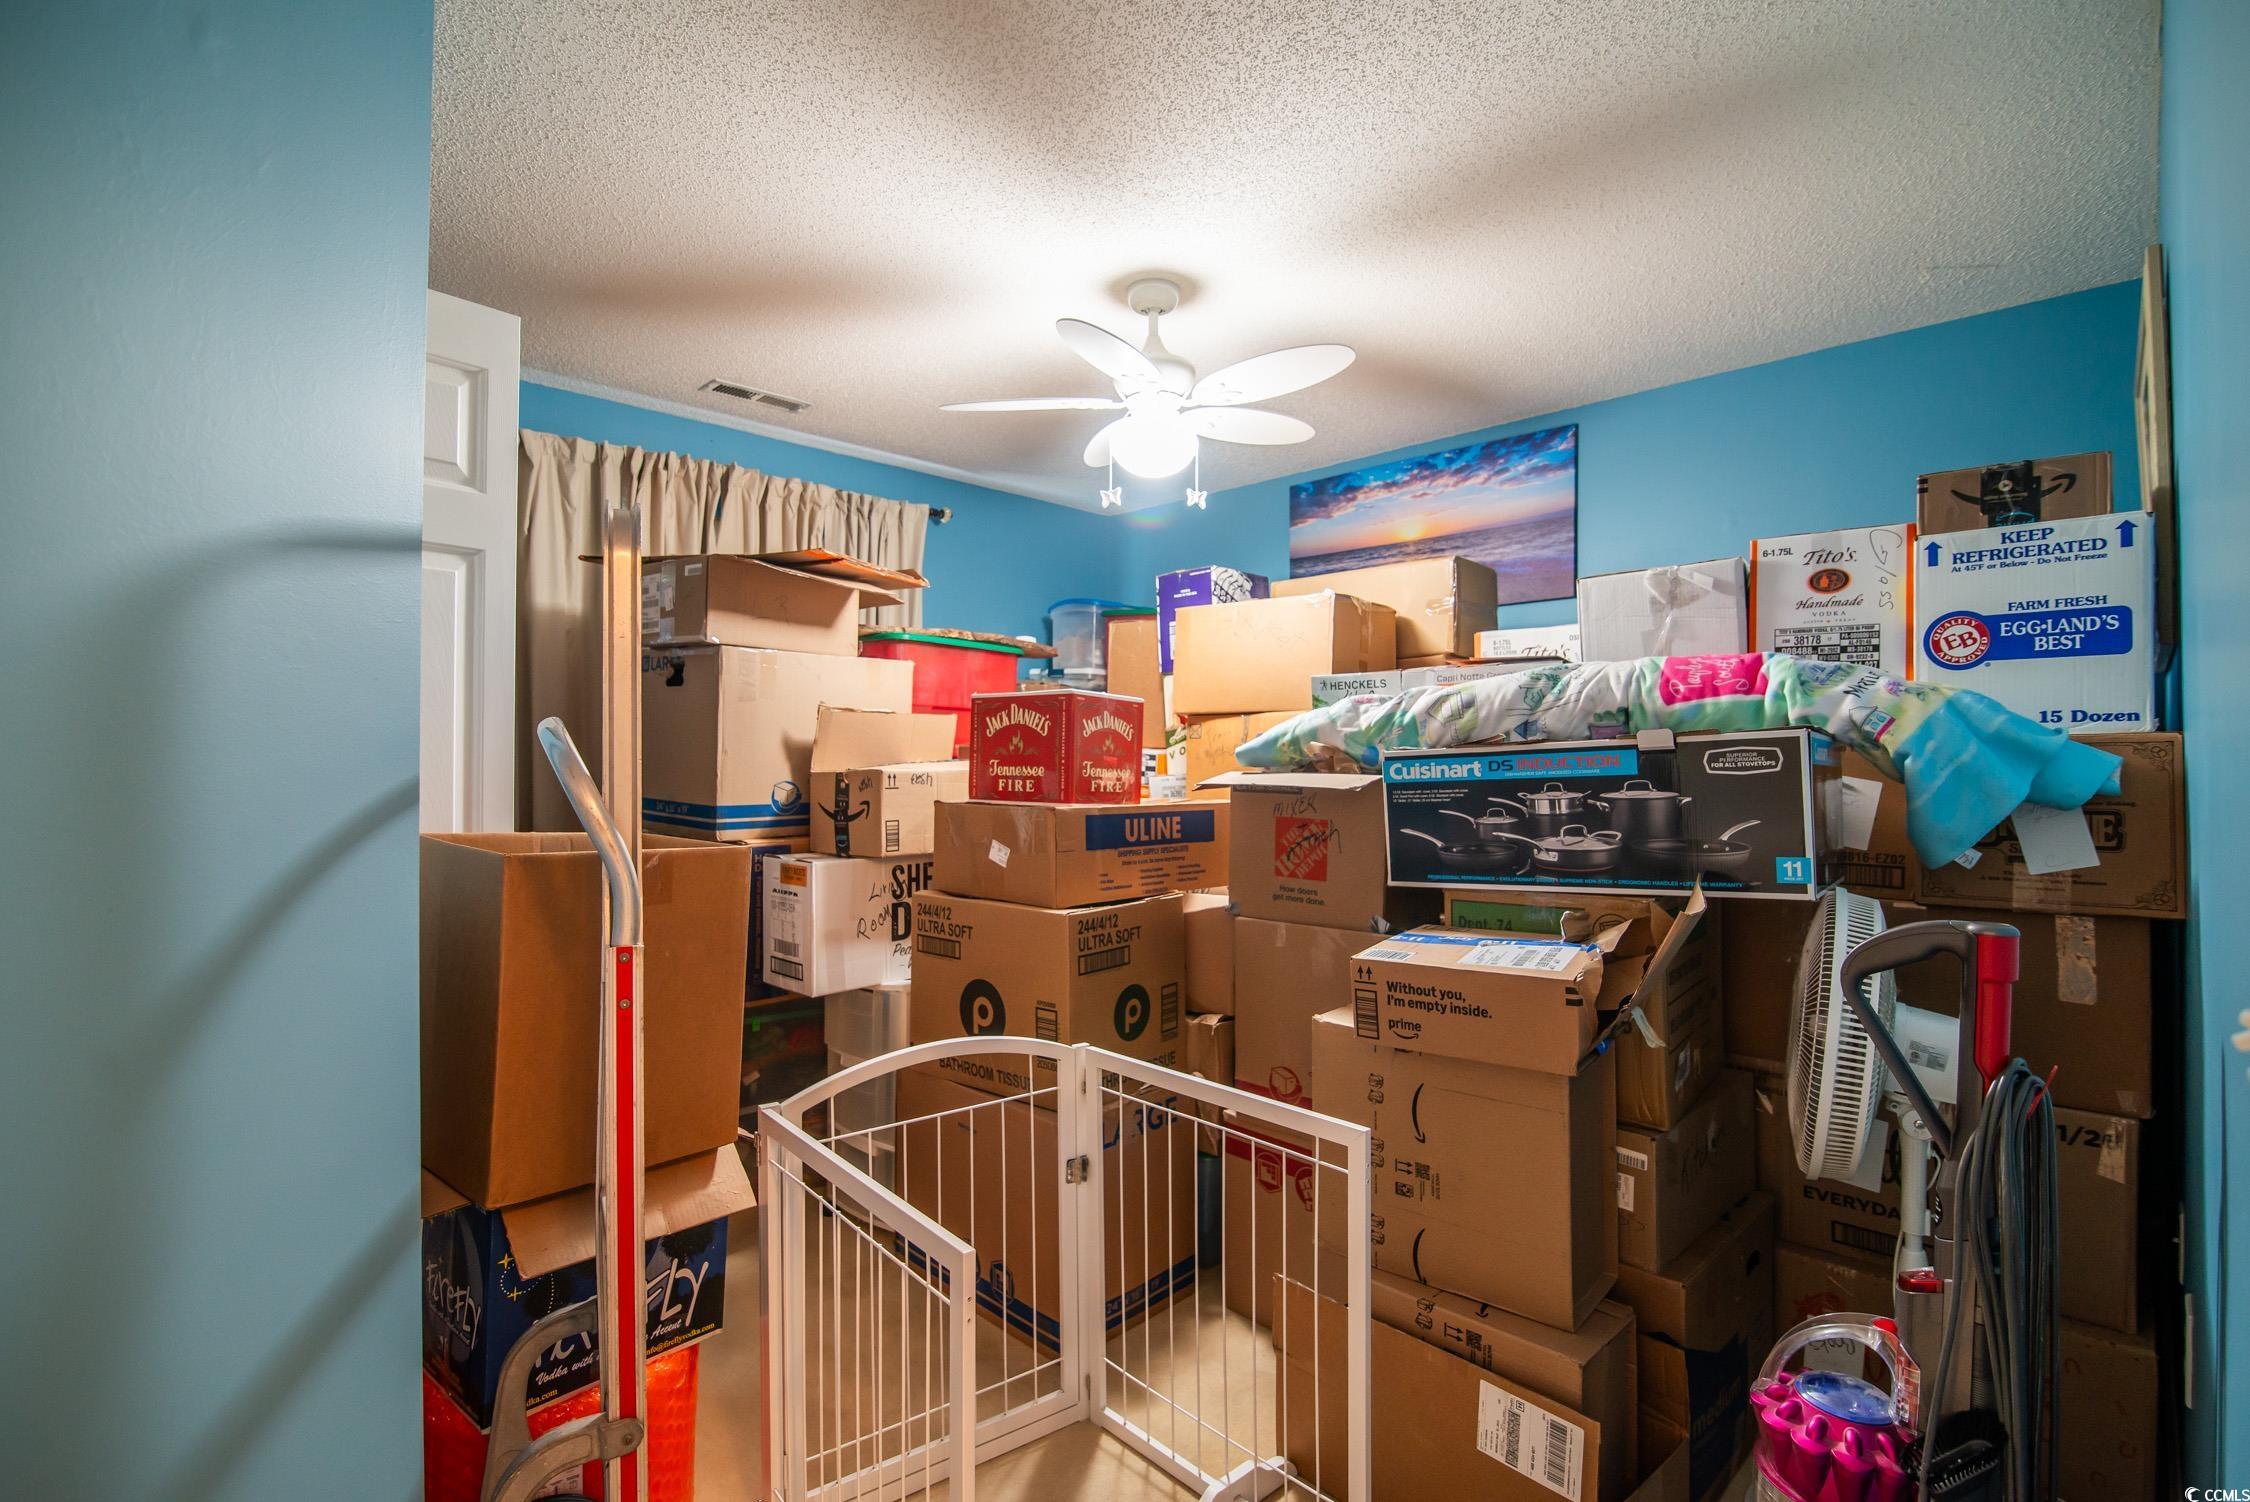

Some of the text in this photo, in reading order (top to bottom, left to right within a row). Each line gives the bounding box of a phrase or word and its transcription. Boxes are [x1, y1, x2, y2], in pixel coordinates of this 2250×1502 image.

[2000, 527, 2055, 545] KEEP
[1763, 548, 1794, 558] 6-1.75L
[1952, 537, 2108, 565] REFRIGERATED
[1951, 565, 1962, 573] At
[2000, 559, 2028, 568] Below
[2037, 557, 2051, 565] Do
[2054, 555, 2071, 563] Not
[2074, 551, 2108, 561] Freeze
[1795, 594, 1864, 610] Handmade
[2008, 595, 2108, 612] FARM FRESH
[1934, 618, 1978, 641] QUALITY
[1794, 635, 1822, 646] 38178
[1937, 636, 1989, 664] APPROVED
[1942, 630, 1979, 652] EB
[2034, 634, 2085, 652] BEST
[1330, 679, 1387, 691] HENCKELS
[986, 703, 1051, 737] JACK DANIEL'S
[1083, 710, 1134, 742] JACK DANIEL'S
[2039, 709, 2141, 723] 15 Dozen
[989, 759, 1045, 777] Tennessee
[1082, 761, 1132, 778] Tennessee
[1389, 754, 1621, 780] Cuisinart DS INDUCTION
[1737, 760, 1776, 768] STOVETOPS
[998, 779, 1035, 792] FIRE
[1091, 779, 1123, 793] FIRE
[1125, 816, 1182, 842] ULINE
[1783, 861, 1802, 877] 11
[917, 903, 952, 920] 244/4/12
[917, 918, 973, 940] ULTRA SOFT
[1078, 914, 1119, 935] 244/4/12
[1078, 925, 1141, 951] ULTRA SOFT
[1387, 981, 1466, 1003] Without you,
[1387, 995, 1493, 1018] I'm empty inside.
[1389, 1017, 1422, 1032] prime
[939, 1057, 994, 1084] BATHROOM
[646, 1323, 715, 1356] nfo@fireflyvodka.com
[650, 1319, 682, 1340] Accent
[535, 1352, 594, 1385] Vodka with
